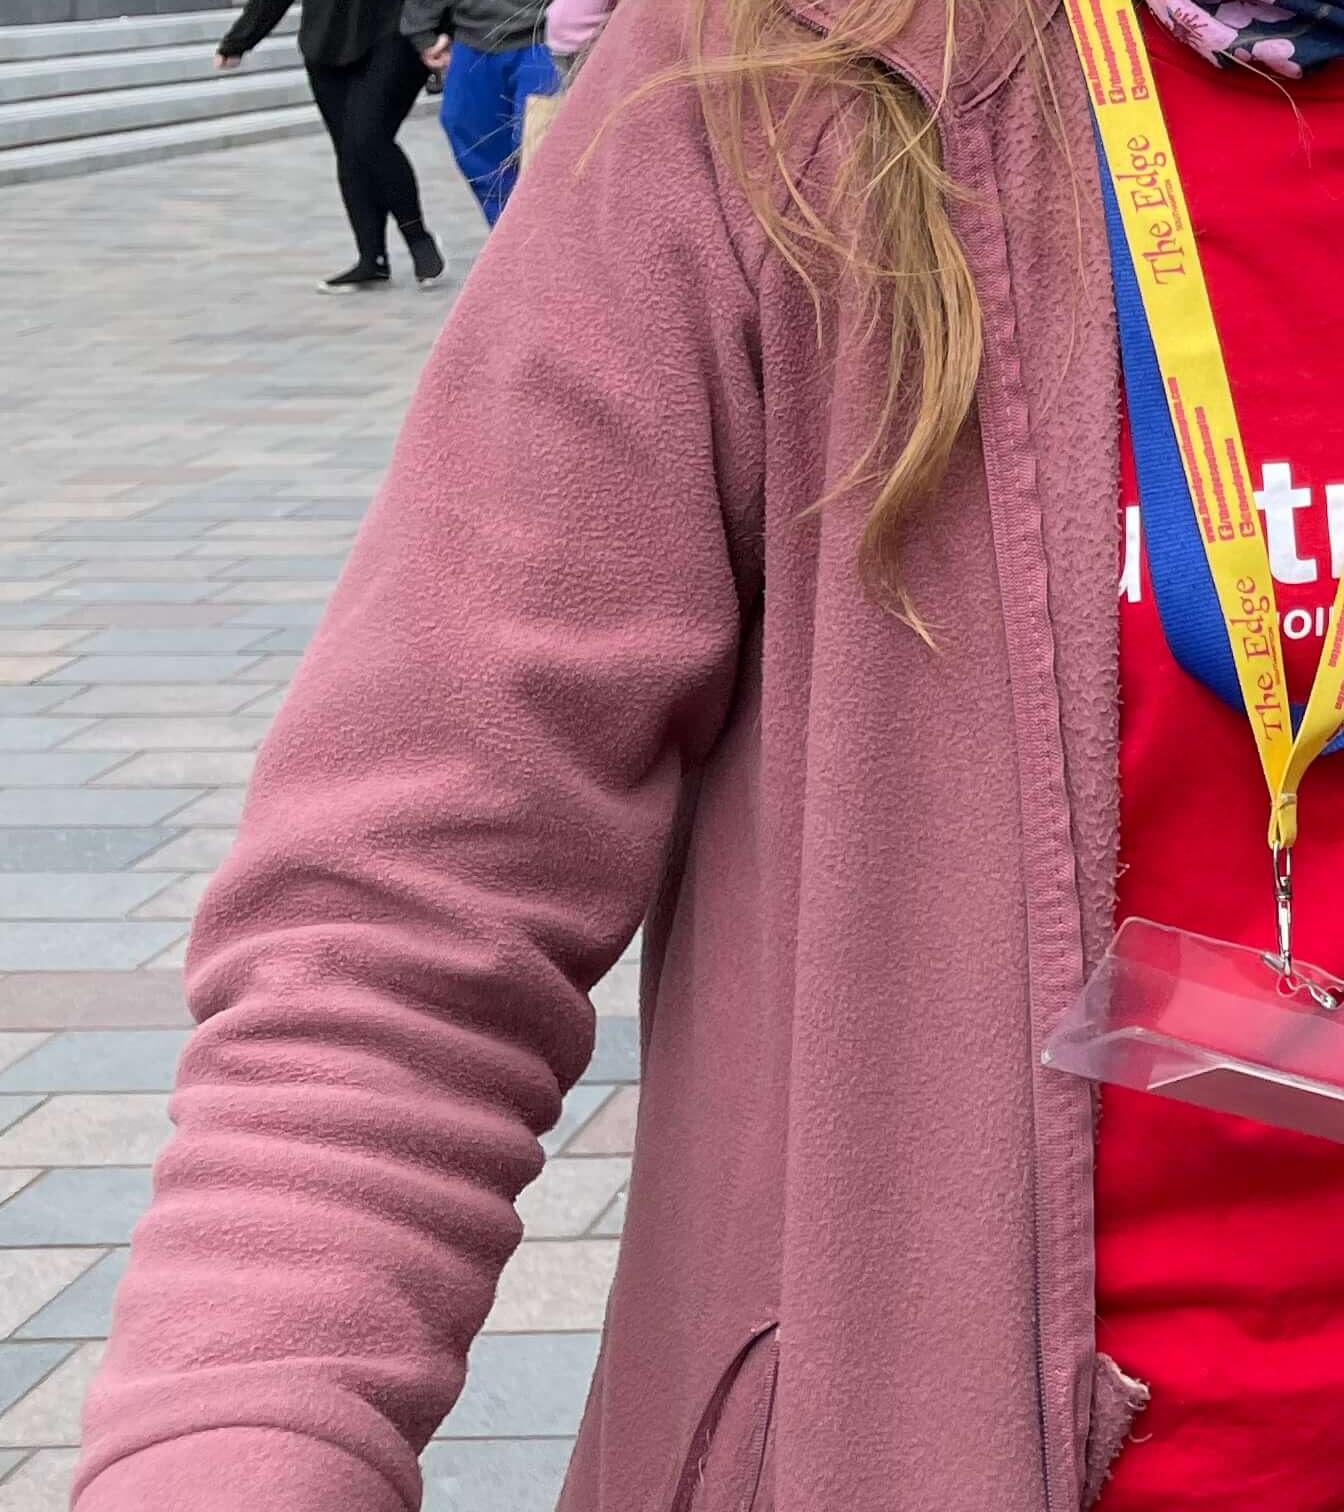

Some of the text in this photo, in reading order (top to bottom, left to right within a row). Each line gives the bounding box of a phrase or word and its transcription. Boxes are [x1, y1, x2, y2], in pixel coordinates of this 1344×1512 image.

[1116, 134, 1185, 285] The Edge
[1229, 575, 1283, 741] The Edge
[1276, 605, 1335, 640] OI
